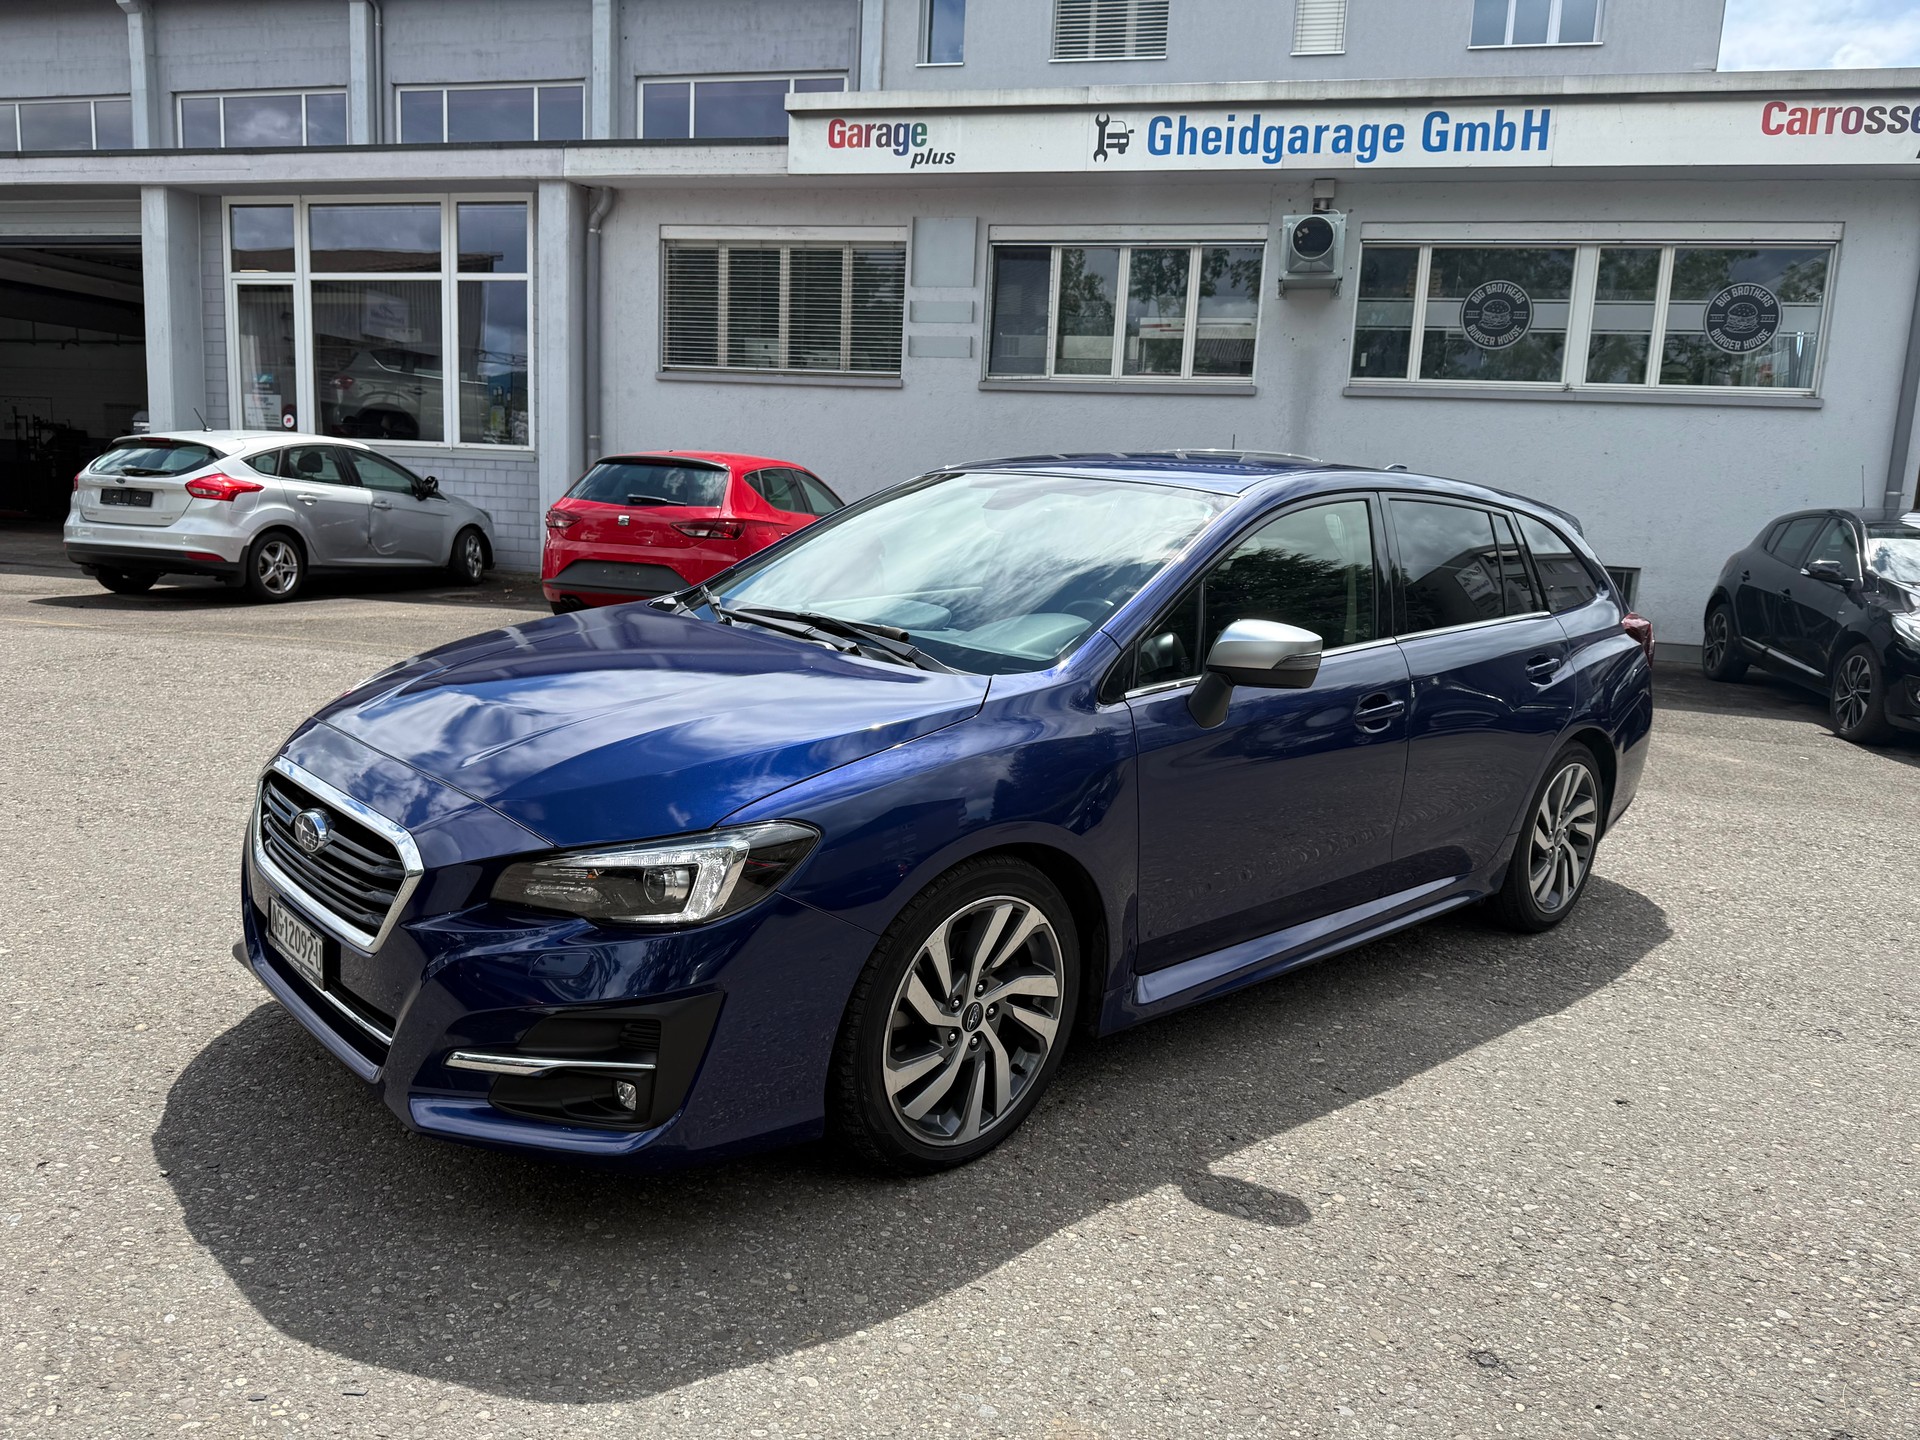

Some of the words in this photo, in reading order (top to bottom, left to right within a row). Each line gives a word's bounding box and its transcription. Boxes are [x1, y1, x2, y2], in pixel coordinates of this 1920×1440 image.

[828, 118, 928, 156] Garage
[1147, 114, 1405, 165] Gheidgarage
[1422, 108, 1551, 154] GmbH
[910, 148, 956, 169] plus
[1471, 289, 1486, 304] BIG
[1485, 283, 1526, 304] BROTHERS
[1715, 292, 1731, 307] BIG
[1731, 286, 1774, 307] BROTHERS
[1467, 324, 1496, 346] BURGER
[1497, 325, 1523, 346] HOUSE
[1711, 328, 1741, 350] BURGER
[1743, 328, 1771, 349] HOUSE
